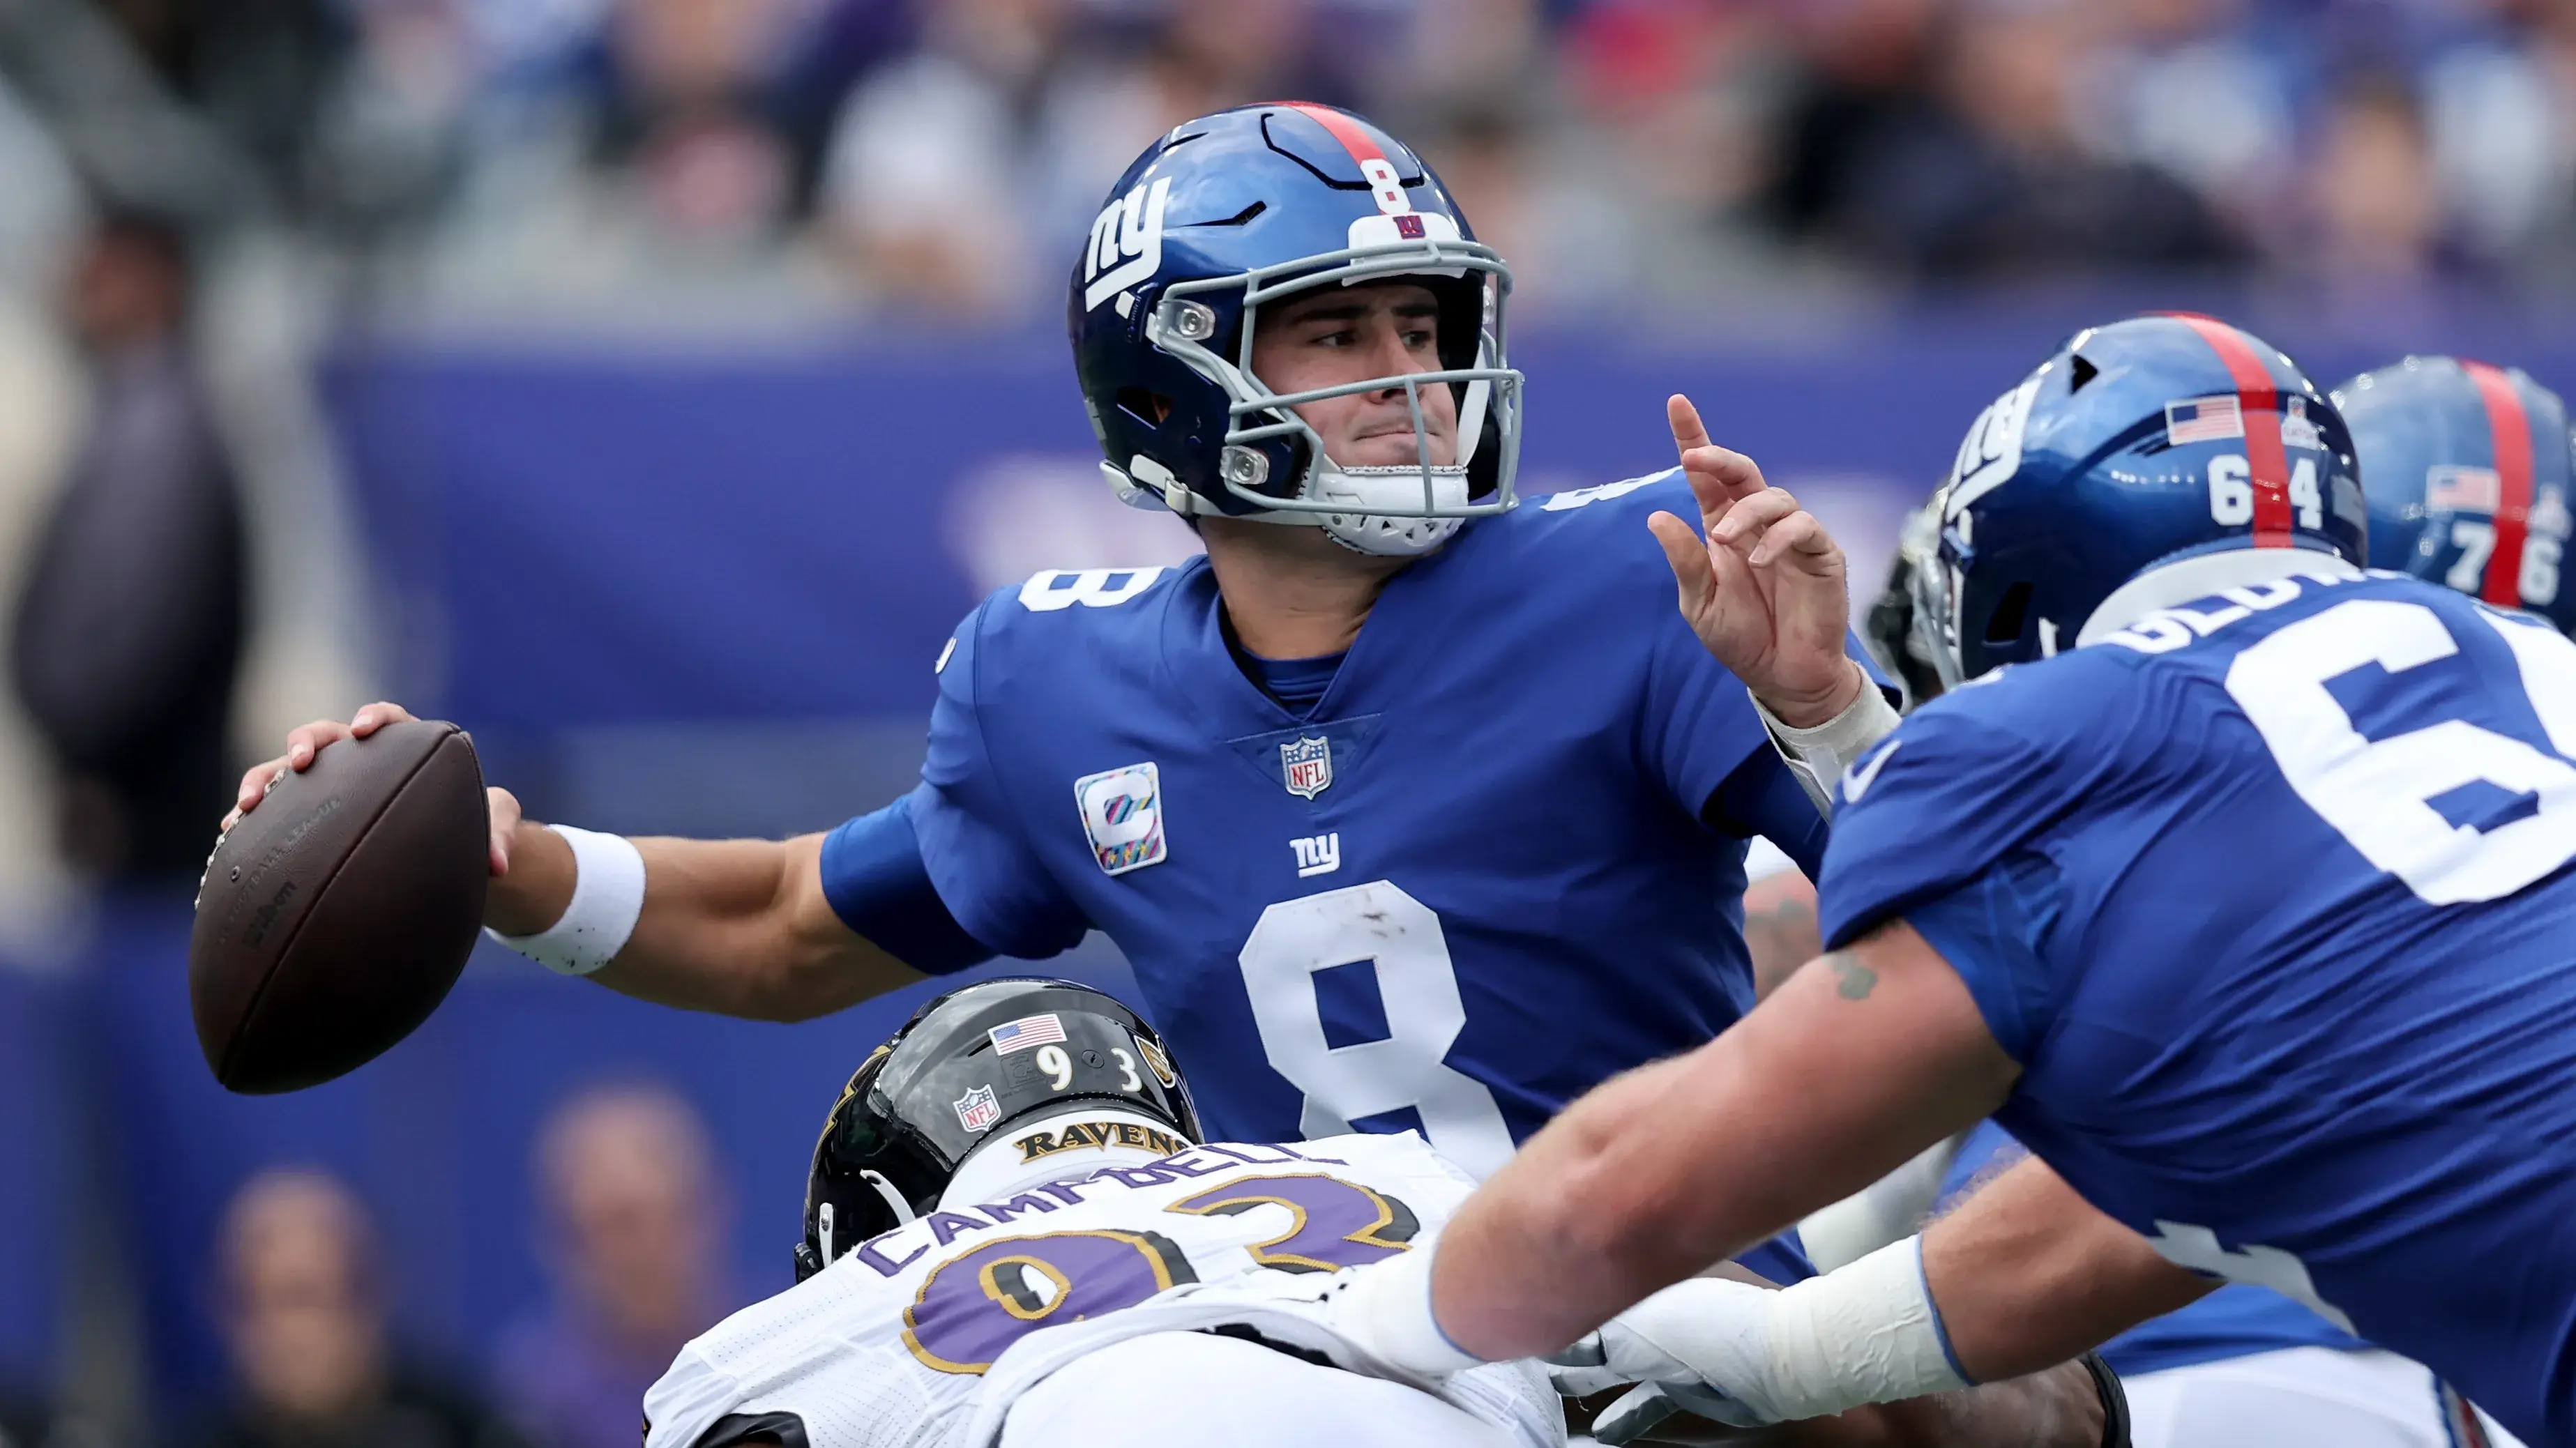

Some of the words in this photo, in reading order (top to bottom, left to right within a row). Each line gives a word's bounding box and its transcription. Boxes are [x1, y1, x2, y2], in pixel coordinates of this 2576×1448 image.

[1360, 158, 1411, 215] 8
[2208, 455, 2322, 529] 64
[1291, 762, 1324, 787] NFL
[1084, 773, 1155, 848] C
[1238, 879, 1517, 1184] 8
[967, 1102, 995, 1126] NFL
